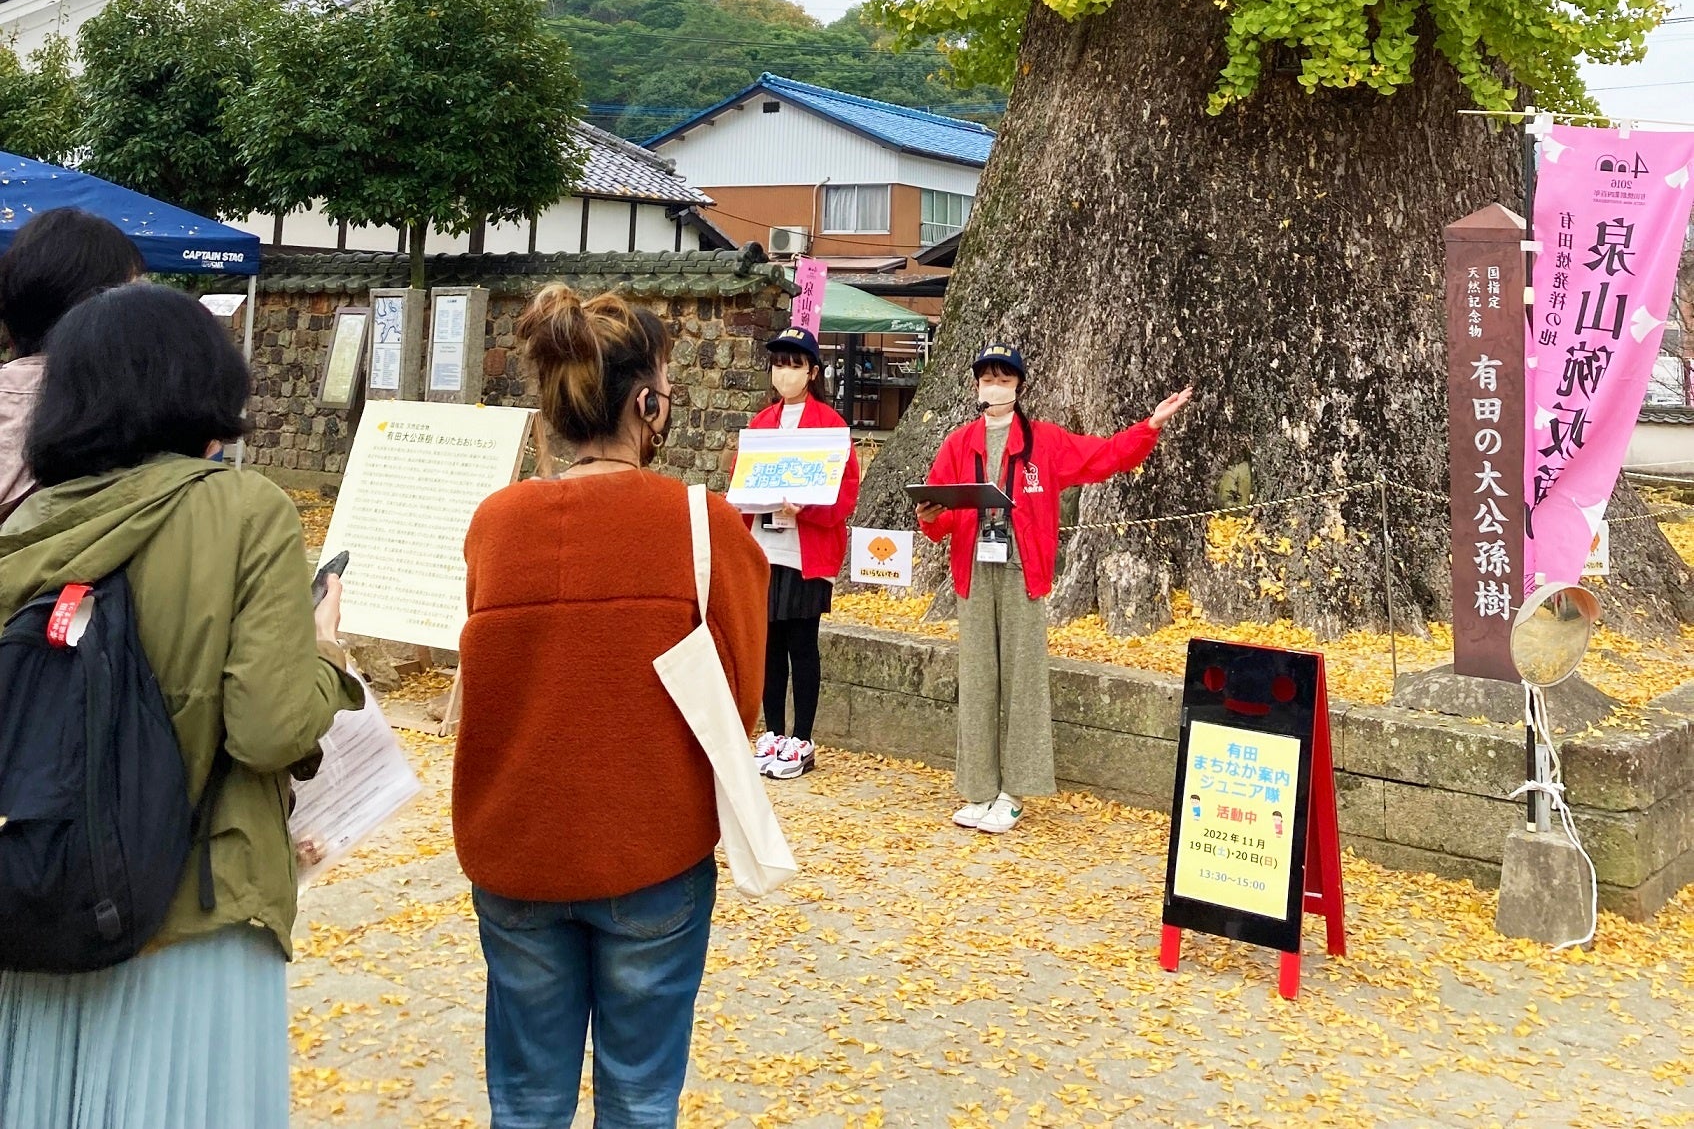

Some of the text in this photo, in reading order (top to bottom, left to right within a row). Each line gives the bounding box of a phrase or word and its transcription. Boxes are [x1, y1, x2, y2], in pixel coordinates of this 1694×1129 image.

[182, 249, 244, 262] CAPTAIN STAG
[1467, 266, 1482, 337] 天然記念物
[1487, 266, 1501, 309] 国指定
[1469, 354, 1512, 621] 有田の大公孫樹
[860, 569, 900, 579] はいらないでね
[1227, 742, 1258, 762] 有田
[1194, 755, 1290, 787] まちなか案内
[1200, 774, 1280, 803] ジュニア隊
[1216, 805, 1257, 825] 活動中
